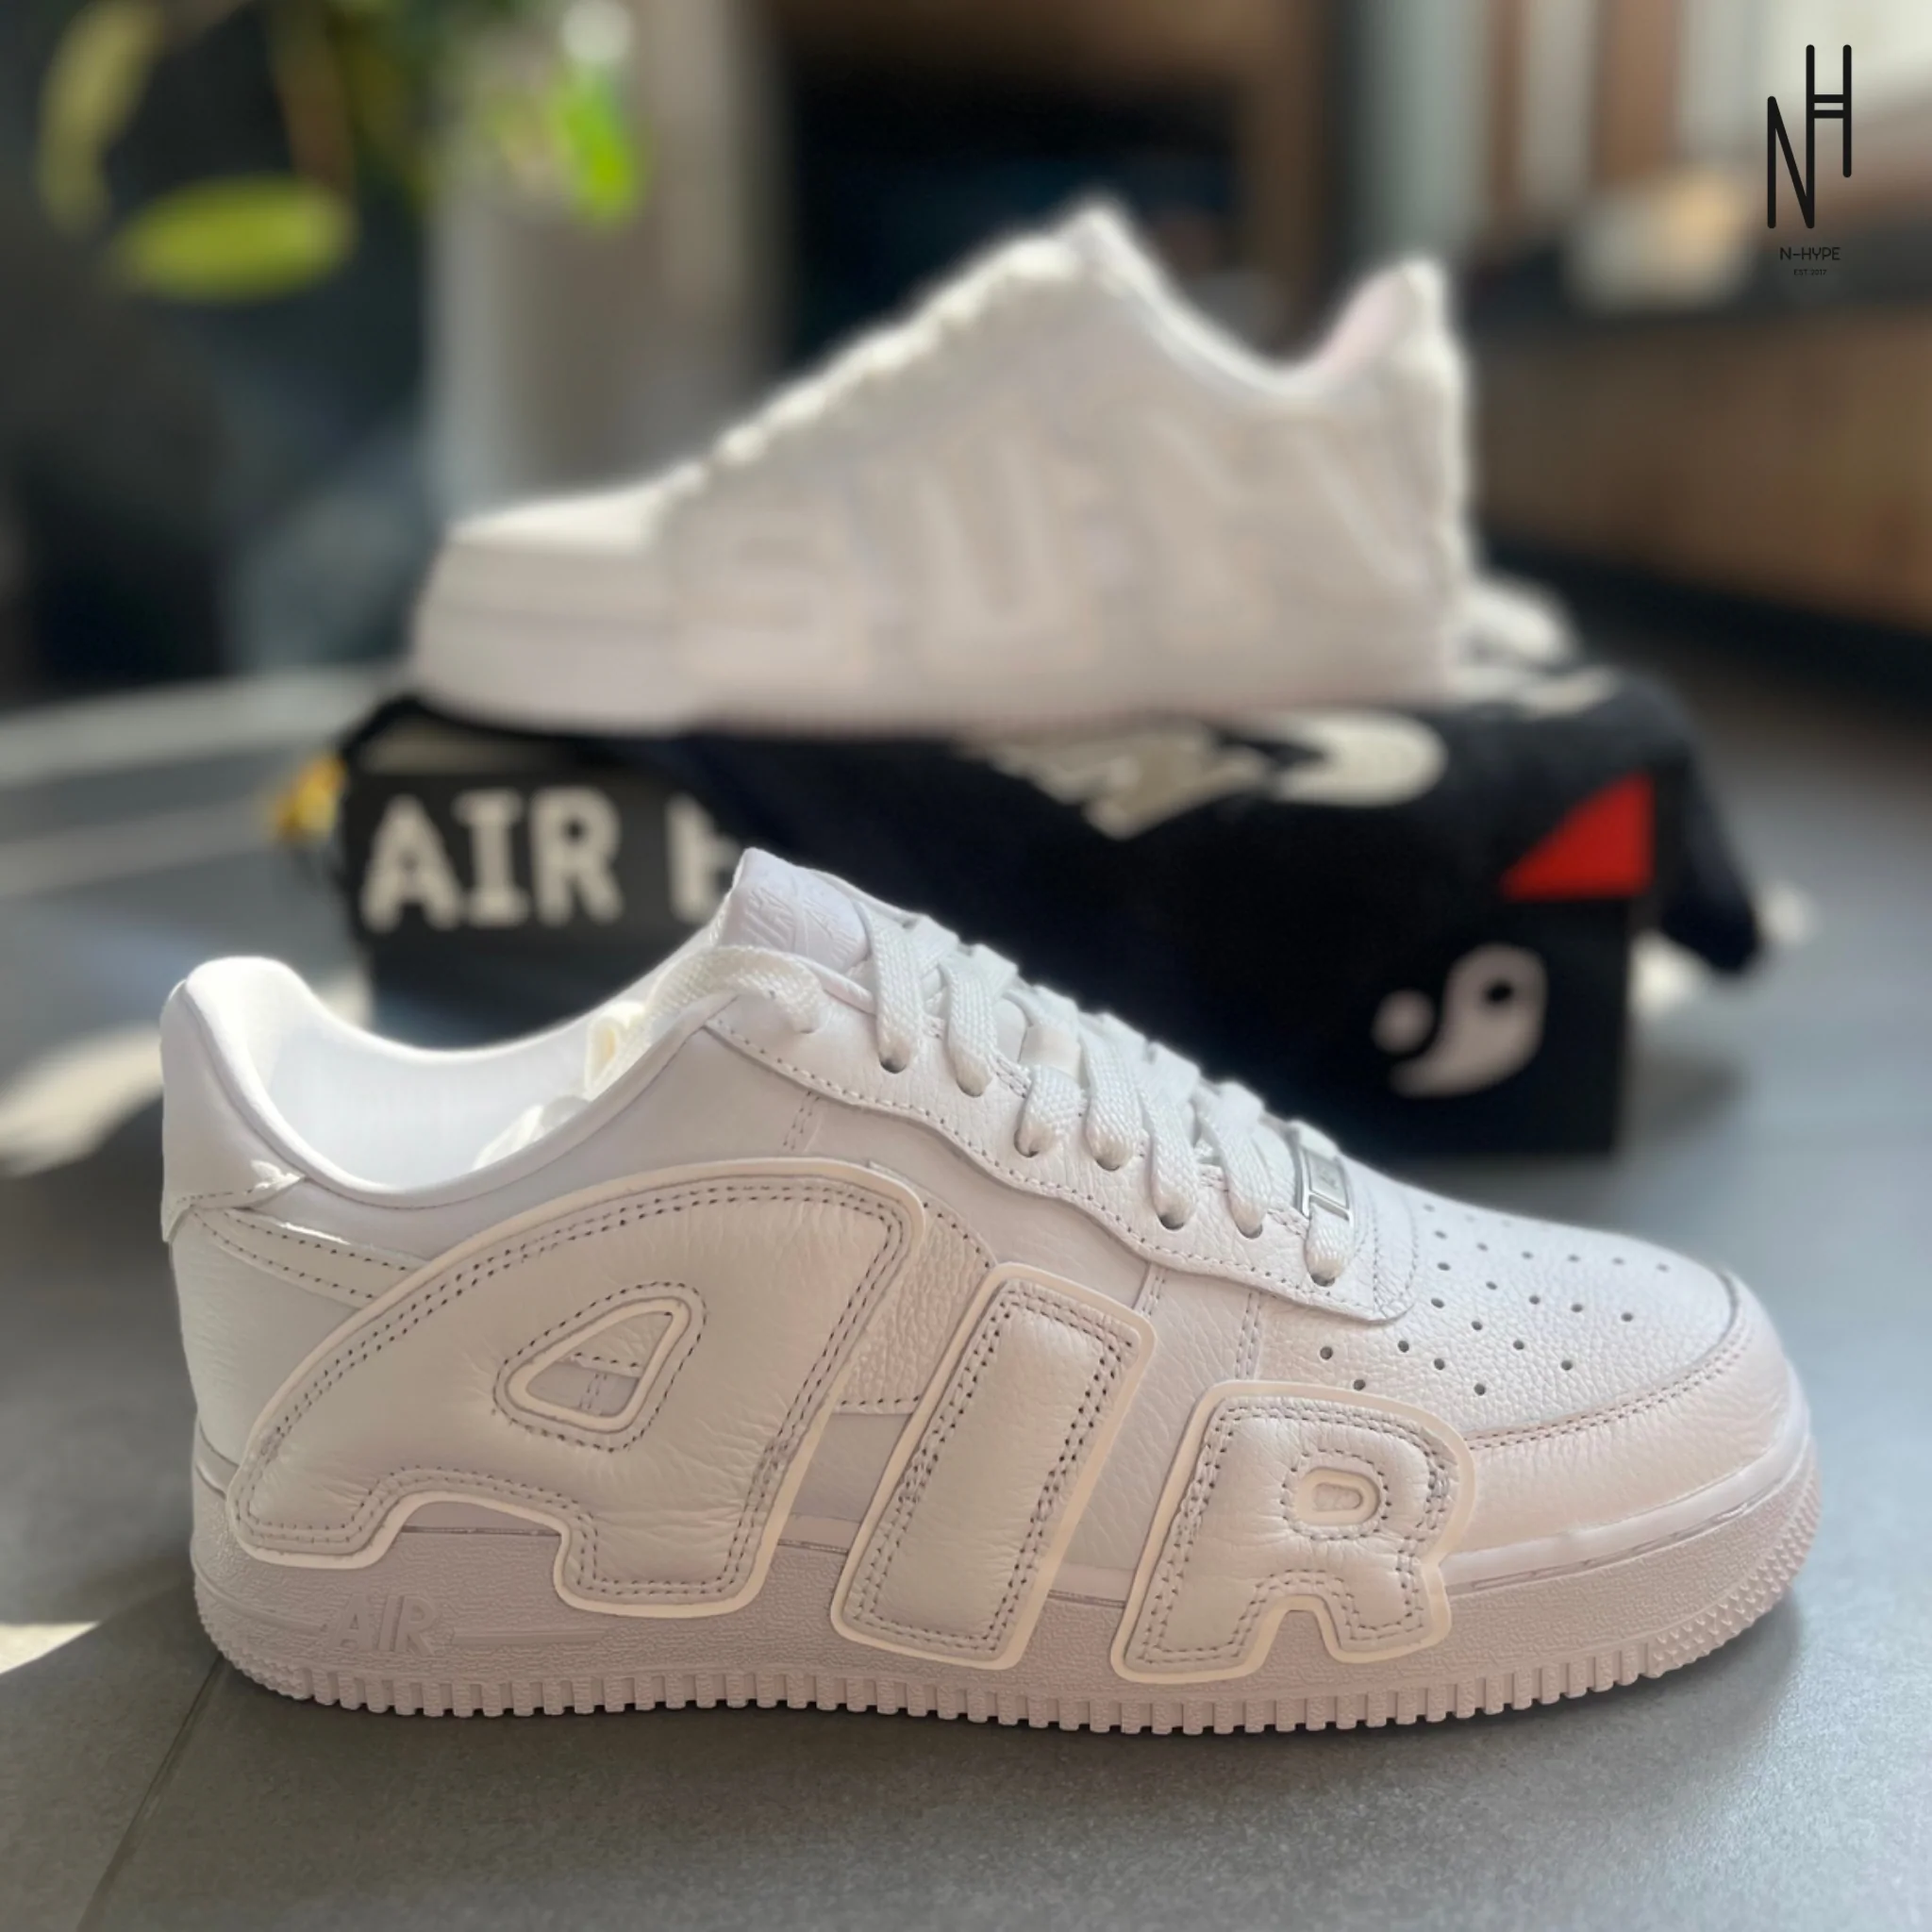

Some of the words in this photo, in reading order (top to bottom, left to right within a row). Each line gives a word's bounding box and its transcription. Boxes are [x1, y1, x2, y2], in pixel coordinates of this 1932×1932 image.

[361, 786, 624, 932] AIR
[225, 1158, 1475, 1683] AIR
[324, 1593, 436, 1657] AIR
